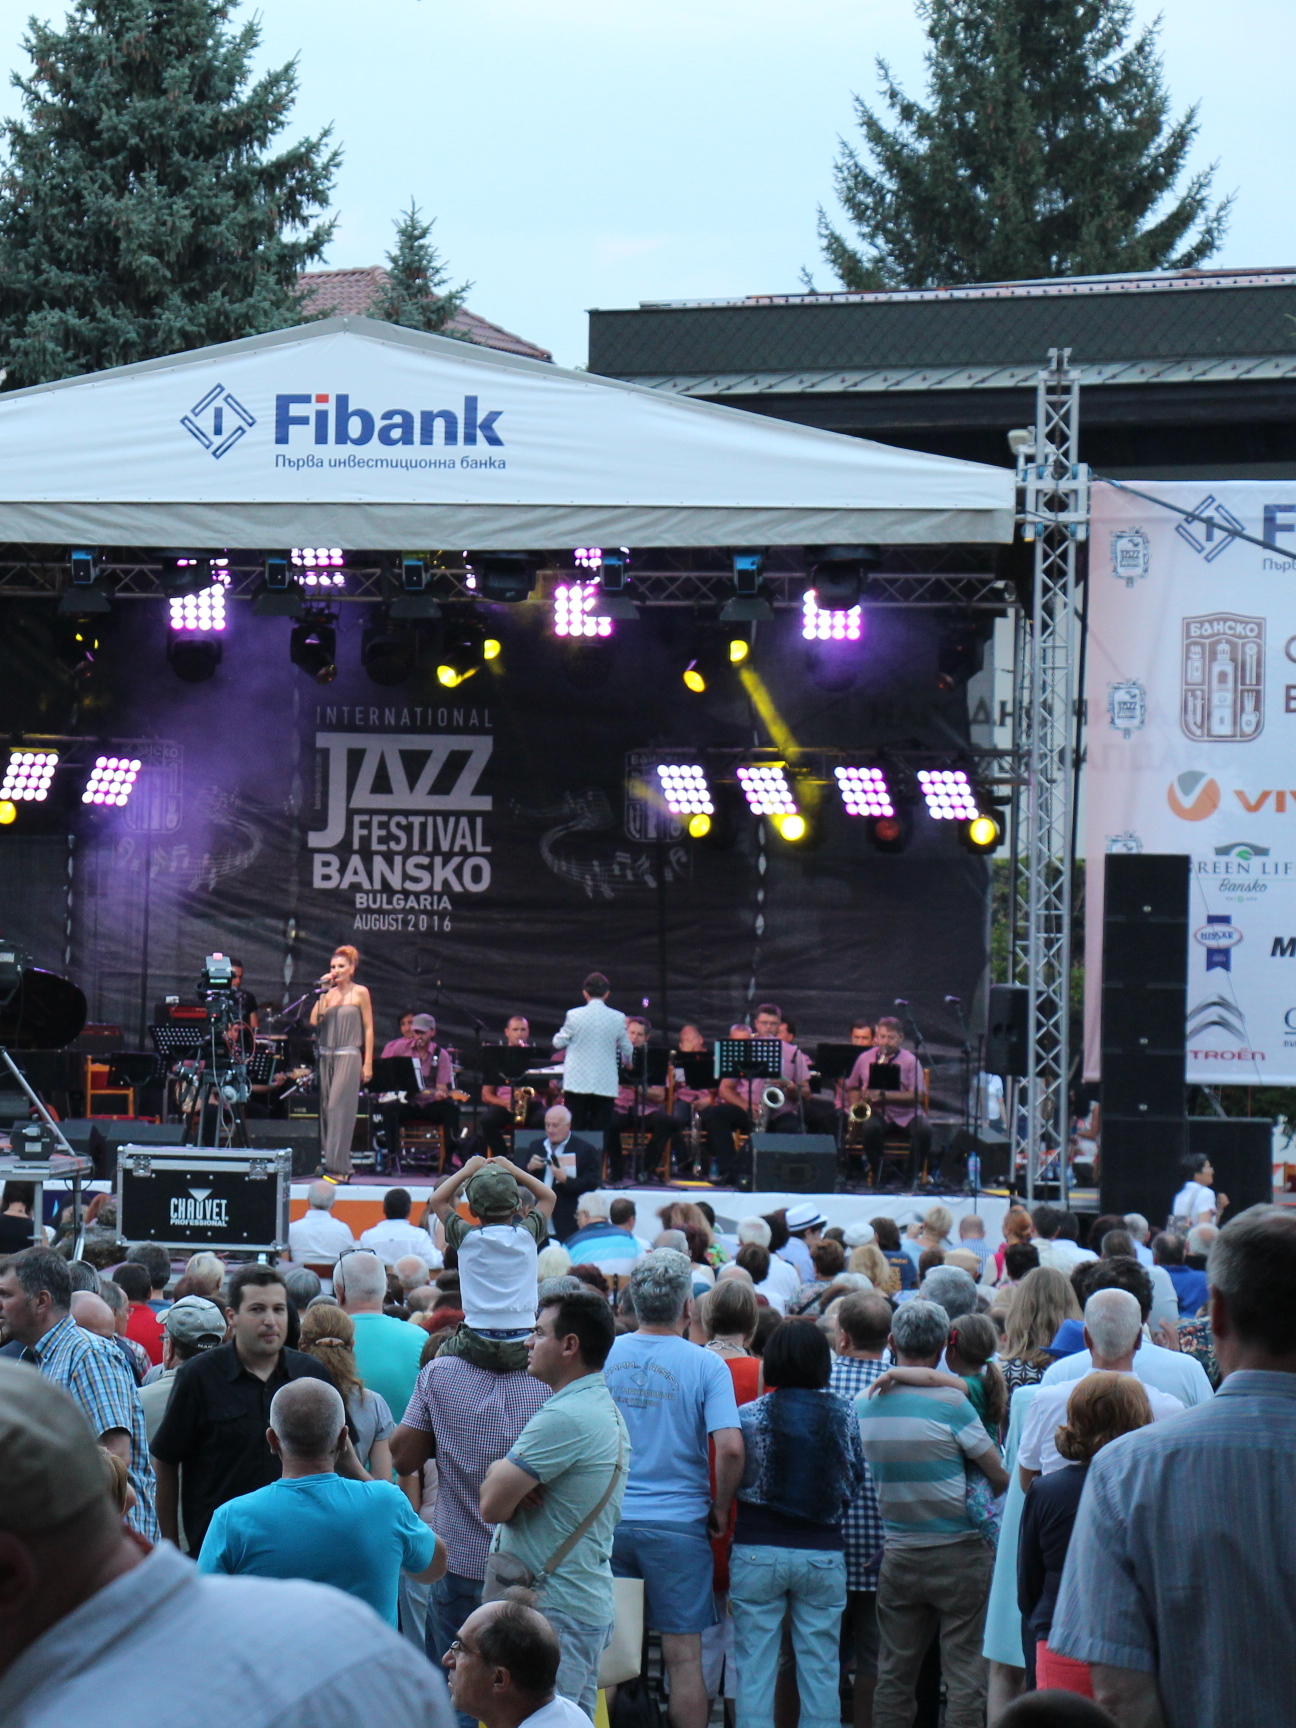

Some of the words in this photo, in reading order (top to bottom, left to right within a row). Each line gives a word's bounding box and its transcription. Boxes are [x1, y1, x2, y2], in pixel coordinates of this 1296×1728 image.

[274, 393, 505, 447] Fibank
[275, 454, 324, 470] Първа
[328, 454, 456, 471] инвестиционна
[460, 455, 506, 470] банка
[316, 706, 493, 727] INTERNATIONAL
[308, 732, 493, 849] JAZZ
[352, 814, 492, 853] FESTIVAL
[312, 853, 492, 893] BANSKO
[1262, 861, 1296, 875] LIF
[1219, 878, 1268, 892] Bansko
[355, 893, 452, 910] BULGARIA
[354, 914, 404, 930] AUGUST
[170, 1197, 228, 1220] CHAUVET
[170, 1219, 228, 1227] PROFESSIONAL
